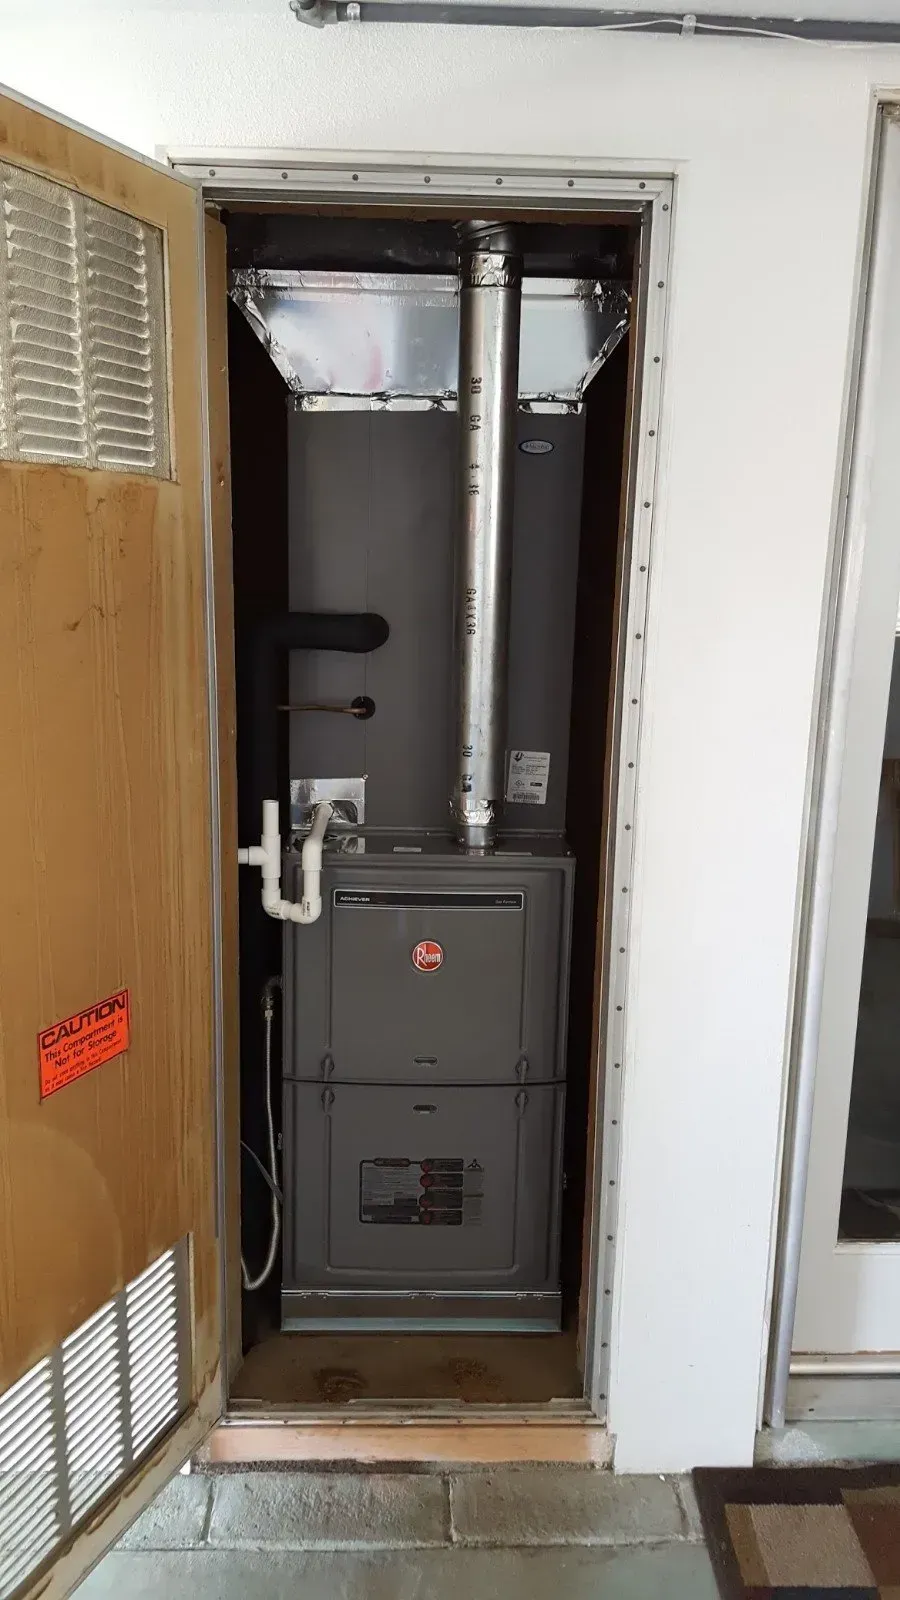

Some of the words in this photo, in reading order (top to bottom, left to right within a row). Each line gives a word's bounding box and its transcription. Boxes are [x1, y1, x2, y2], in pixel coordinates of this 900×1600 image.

[470, 377, 482, 394] 30
[469, 415, 482, 431] GA
[462, 745, 473, 757] 30
[416, 944, 441, 967] Rheem
[41, 994, 126, 1050] CAUTION
[45, 1048, 61, 1062] This
[62, 1020, 115, 1052] Compartment
[118, 1014, 124, 1024] is
[55, 1054, 70, 1069] Not
[73, 1047, 84, 1059] for
[88, 1030, 117, 1051] Storage
